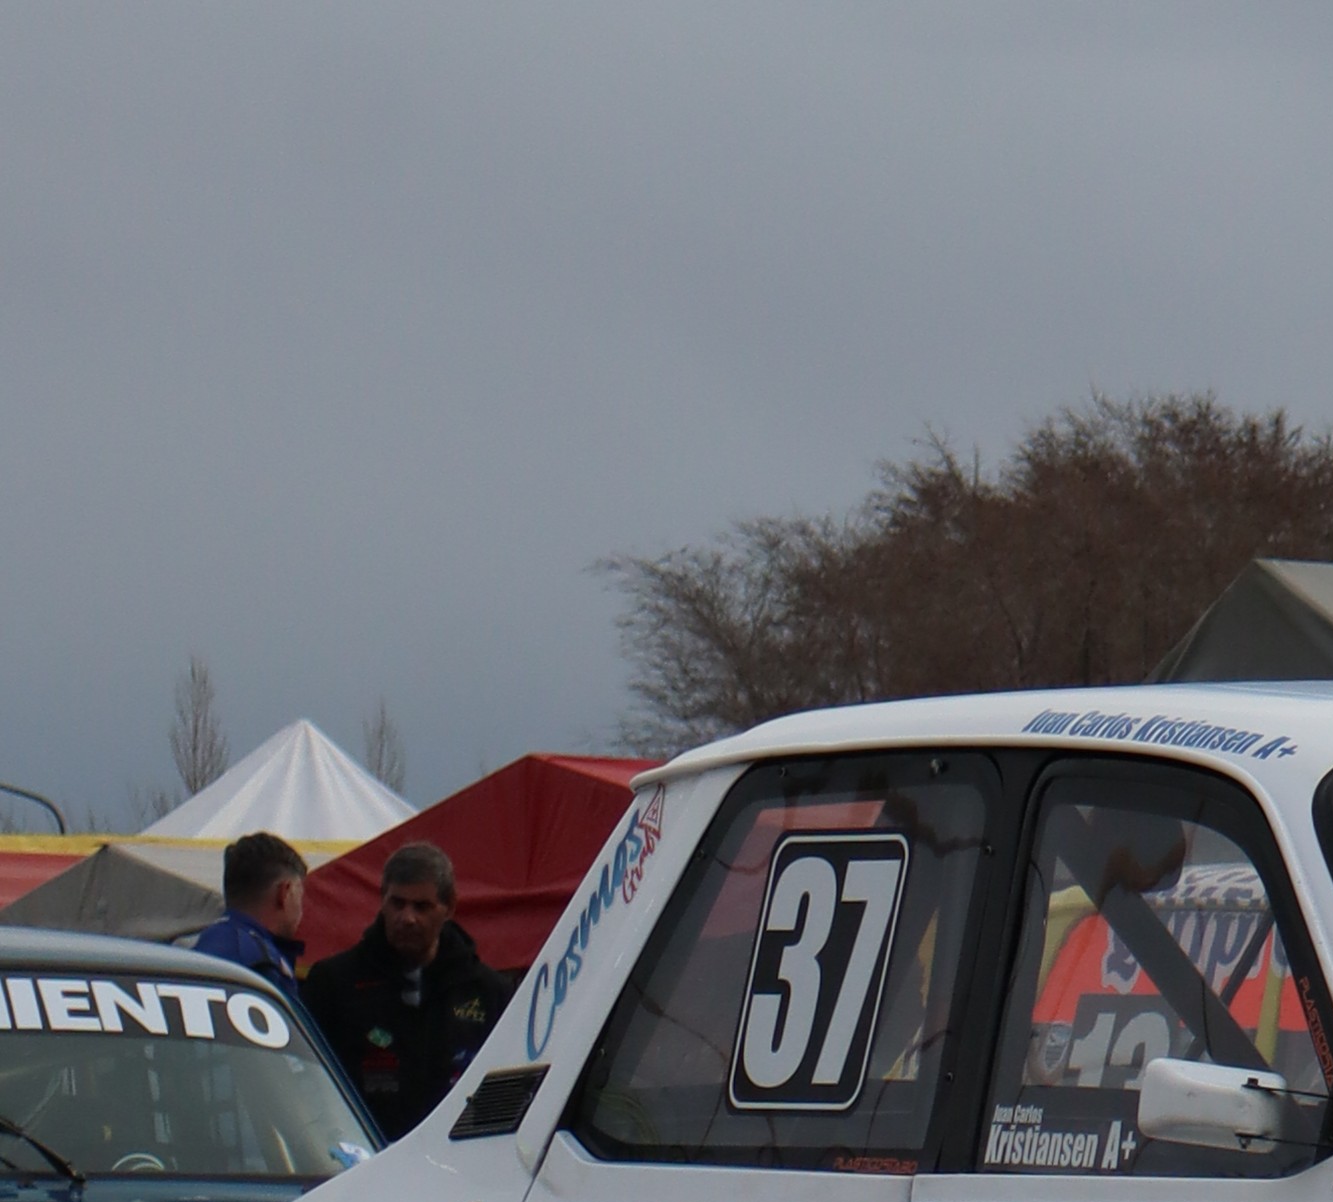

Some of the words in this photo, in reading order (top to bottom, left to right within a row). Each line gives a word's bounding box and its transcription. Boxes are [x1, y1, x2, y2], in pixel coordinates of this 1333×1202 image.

[1068, 709, 1141, 739] Carlos
[1132, 714, 1265, 755] Kristiansen
[1251, 735, 1298, 760] A+
[526, 809, 643, 1062] Cosmos
[742, 855, 900, 1089] 37
[0, 976, 290, 1049] IENTO
[984, 1124, 1099, 1168] Kristiansen
[1101, 1120, 1136, 1170] A+
[1013, 1105, 1043, 1124] Carlos
